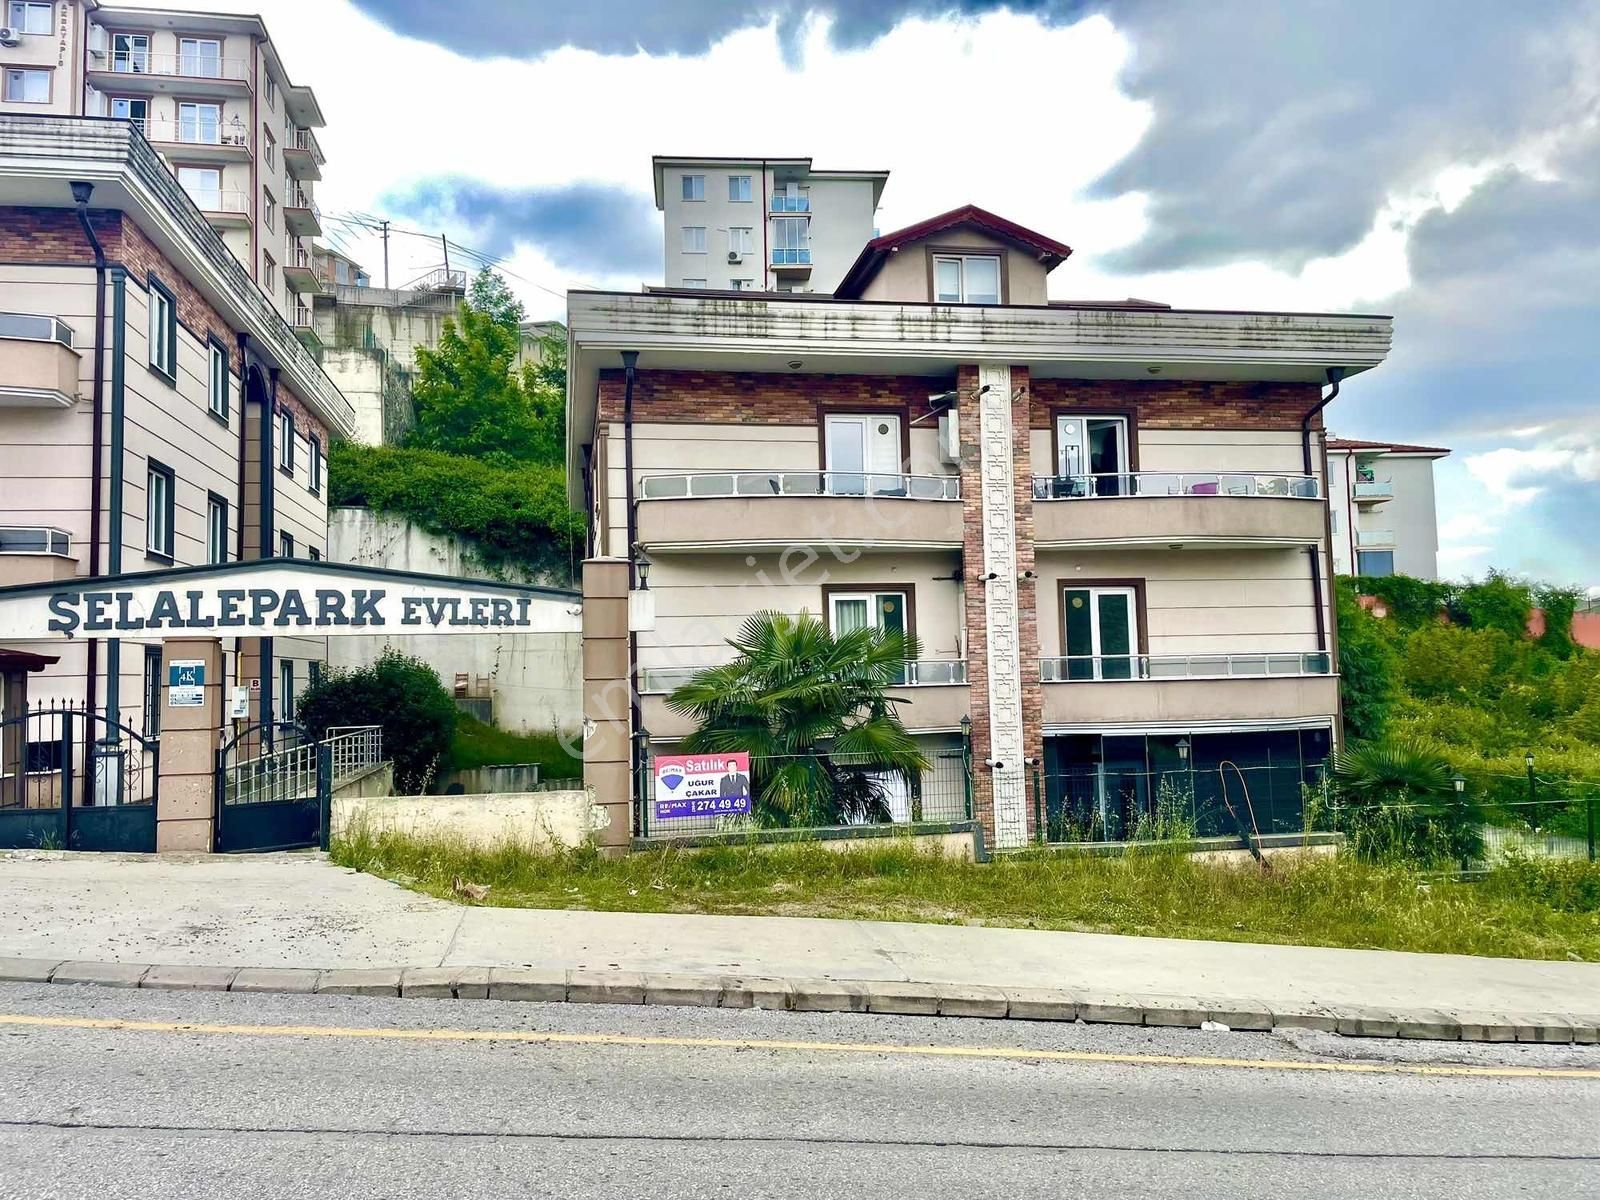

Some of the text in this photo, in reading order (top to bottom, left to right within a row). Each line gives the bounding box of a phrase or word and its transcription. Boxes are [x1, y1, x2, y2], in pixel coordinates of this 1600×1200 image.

[48, 589, 386, 640] ŞELALEPARK
[686, 759, 725, 772] Satılık
[686, 789, 717, 797] ÇAKAR
[697, 801, 716, 811] 274
[719, 799, 731, 809] 49
[734, 798, 747, 808] 49
